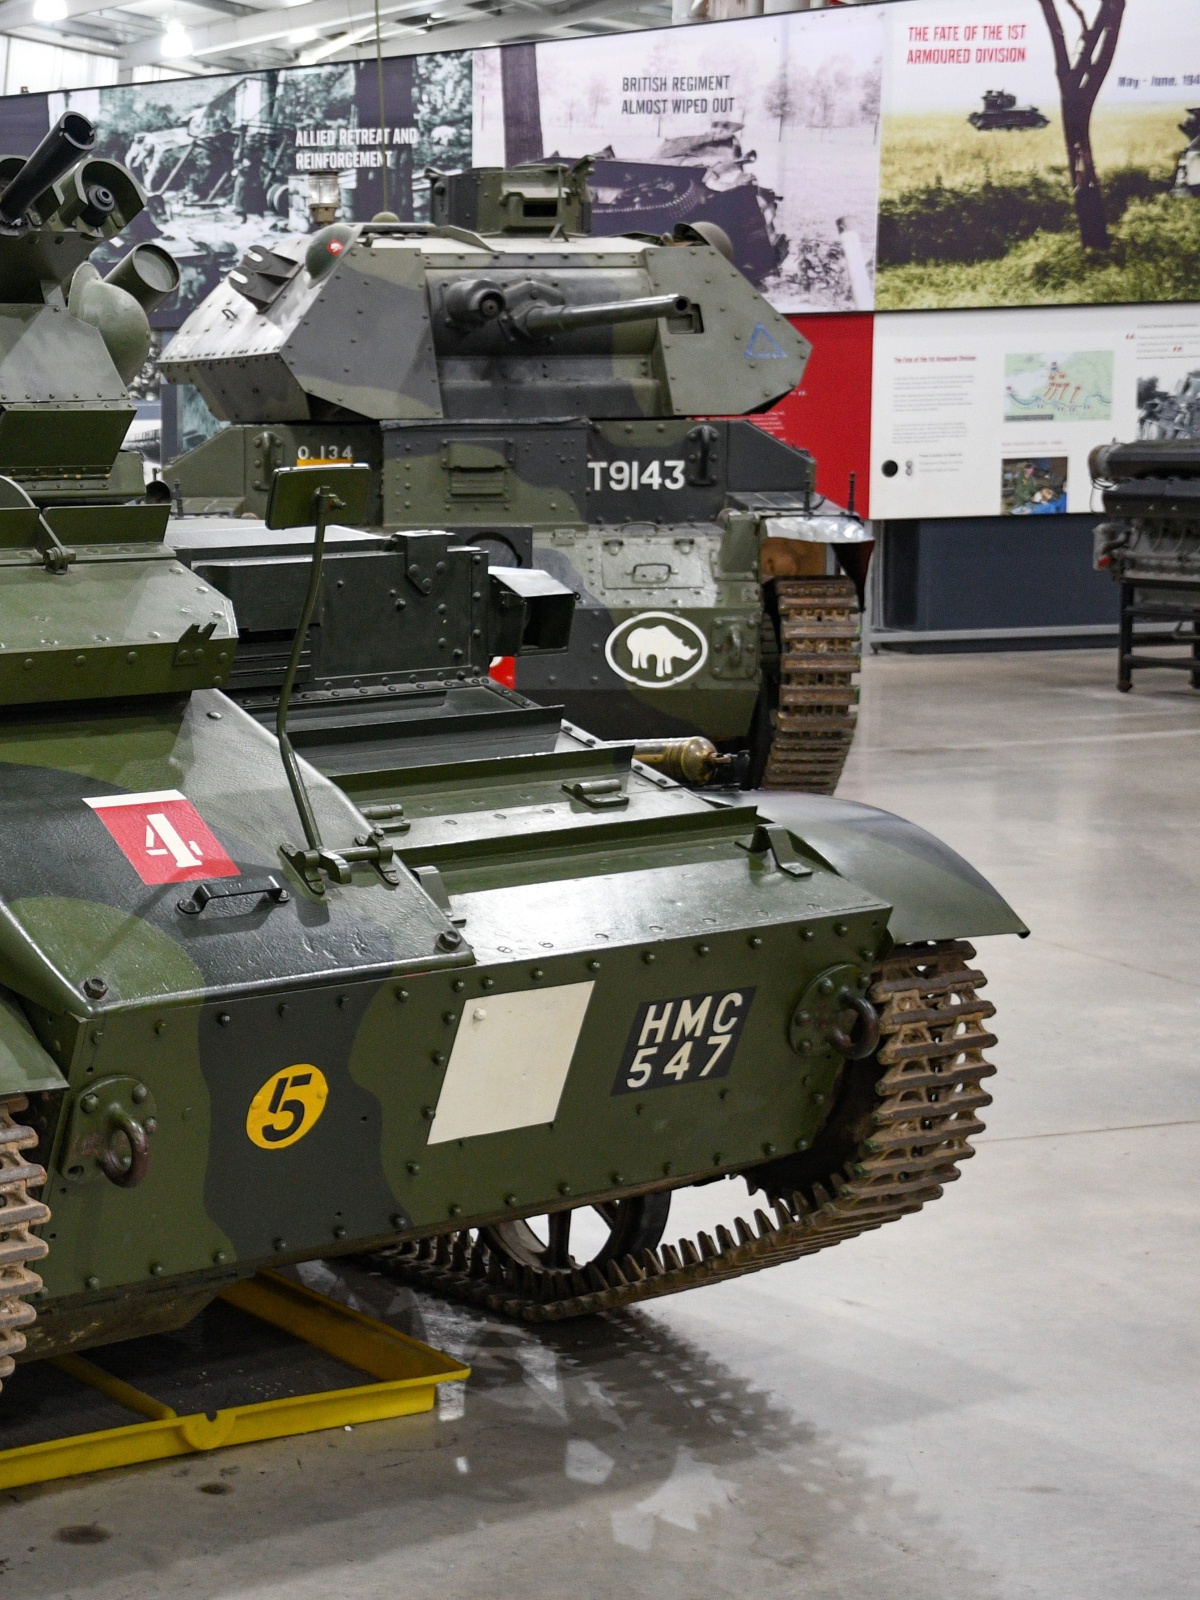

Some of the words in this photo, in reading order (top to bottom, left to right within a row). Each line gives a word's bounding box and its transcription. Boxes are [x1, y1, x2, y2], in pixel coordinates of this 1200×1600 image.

[908, 26, 929, 41] THE
[933, 26, 960, 41] FATE
[964, 25, 979, 41] OF
[983, 25, 1003, 40] THE
[906, 48, 971, 64] ARMOURED
[975, 47, 1027, 63] DIVISION
[622, 76, 667, 92] BRITISH
[672, 75, 731, 92] REGIMENT
[621, 99, 668, 115] ALMOST
[672, 98, 708, 114] WIPED
[712, 97, 735, 113] OUT
[295, 130, 336, 147] ALLIED
[339, 128, 392, 146] RETREAT
[392, 127, 419, 145] AND
[295, 151, 393, 170] REINFORCEMENT
[587, 460, 685, 491] T9143
[637, 992, 743, 1047] HMC
[626, 1033, 733, 1088] 547
[261, 1072, 313, 1142] 5
